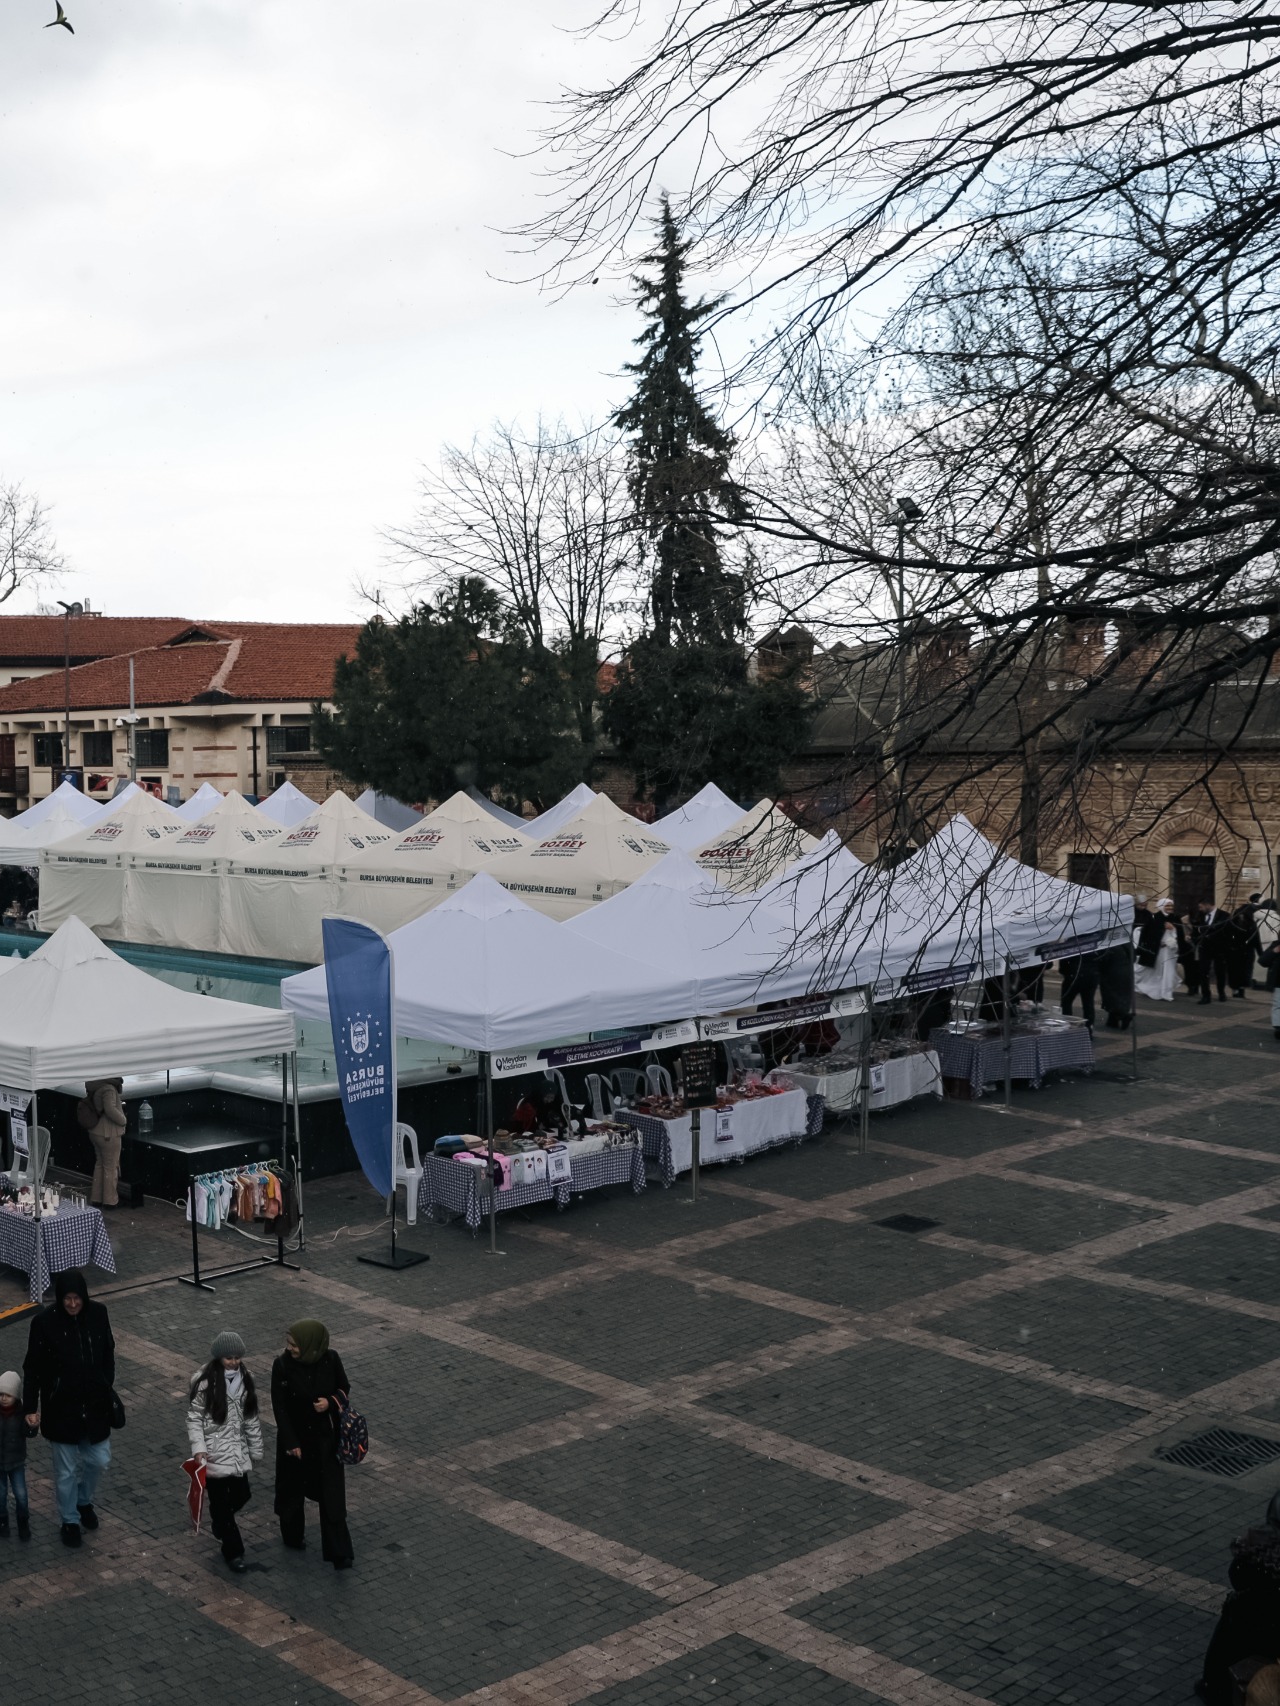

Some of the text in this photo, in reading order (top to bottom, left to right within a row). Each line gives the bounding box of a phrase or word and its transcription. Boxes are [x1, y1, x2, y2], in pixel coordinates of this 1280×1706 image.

[287, 832, 320, 840] BOZBEY
[403, 834, 445, 842] BOZBEY
[258, 867, 283, 876] BÜYÜKŞEHİR
[376, 874, 405, 884] BÜYÜKŞEHİR
[406, 876, 434, 885] BELEDİYESİ
[510, 883, 544, 894] BÜYÜKŞEHİR
[544, 886, 577, 895] BELEDİYESİ
[710, 1020, 729, 1030] Meydan
[566, 1046, 623, 1062] İŞLETME KOOPERATİFİ
[502, 1054, 527, 1065] Meydan
